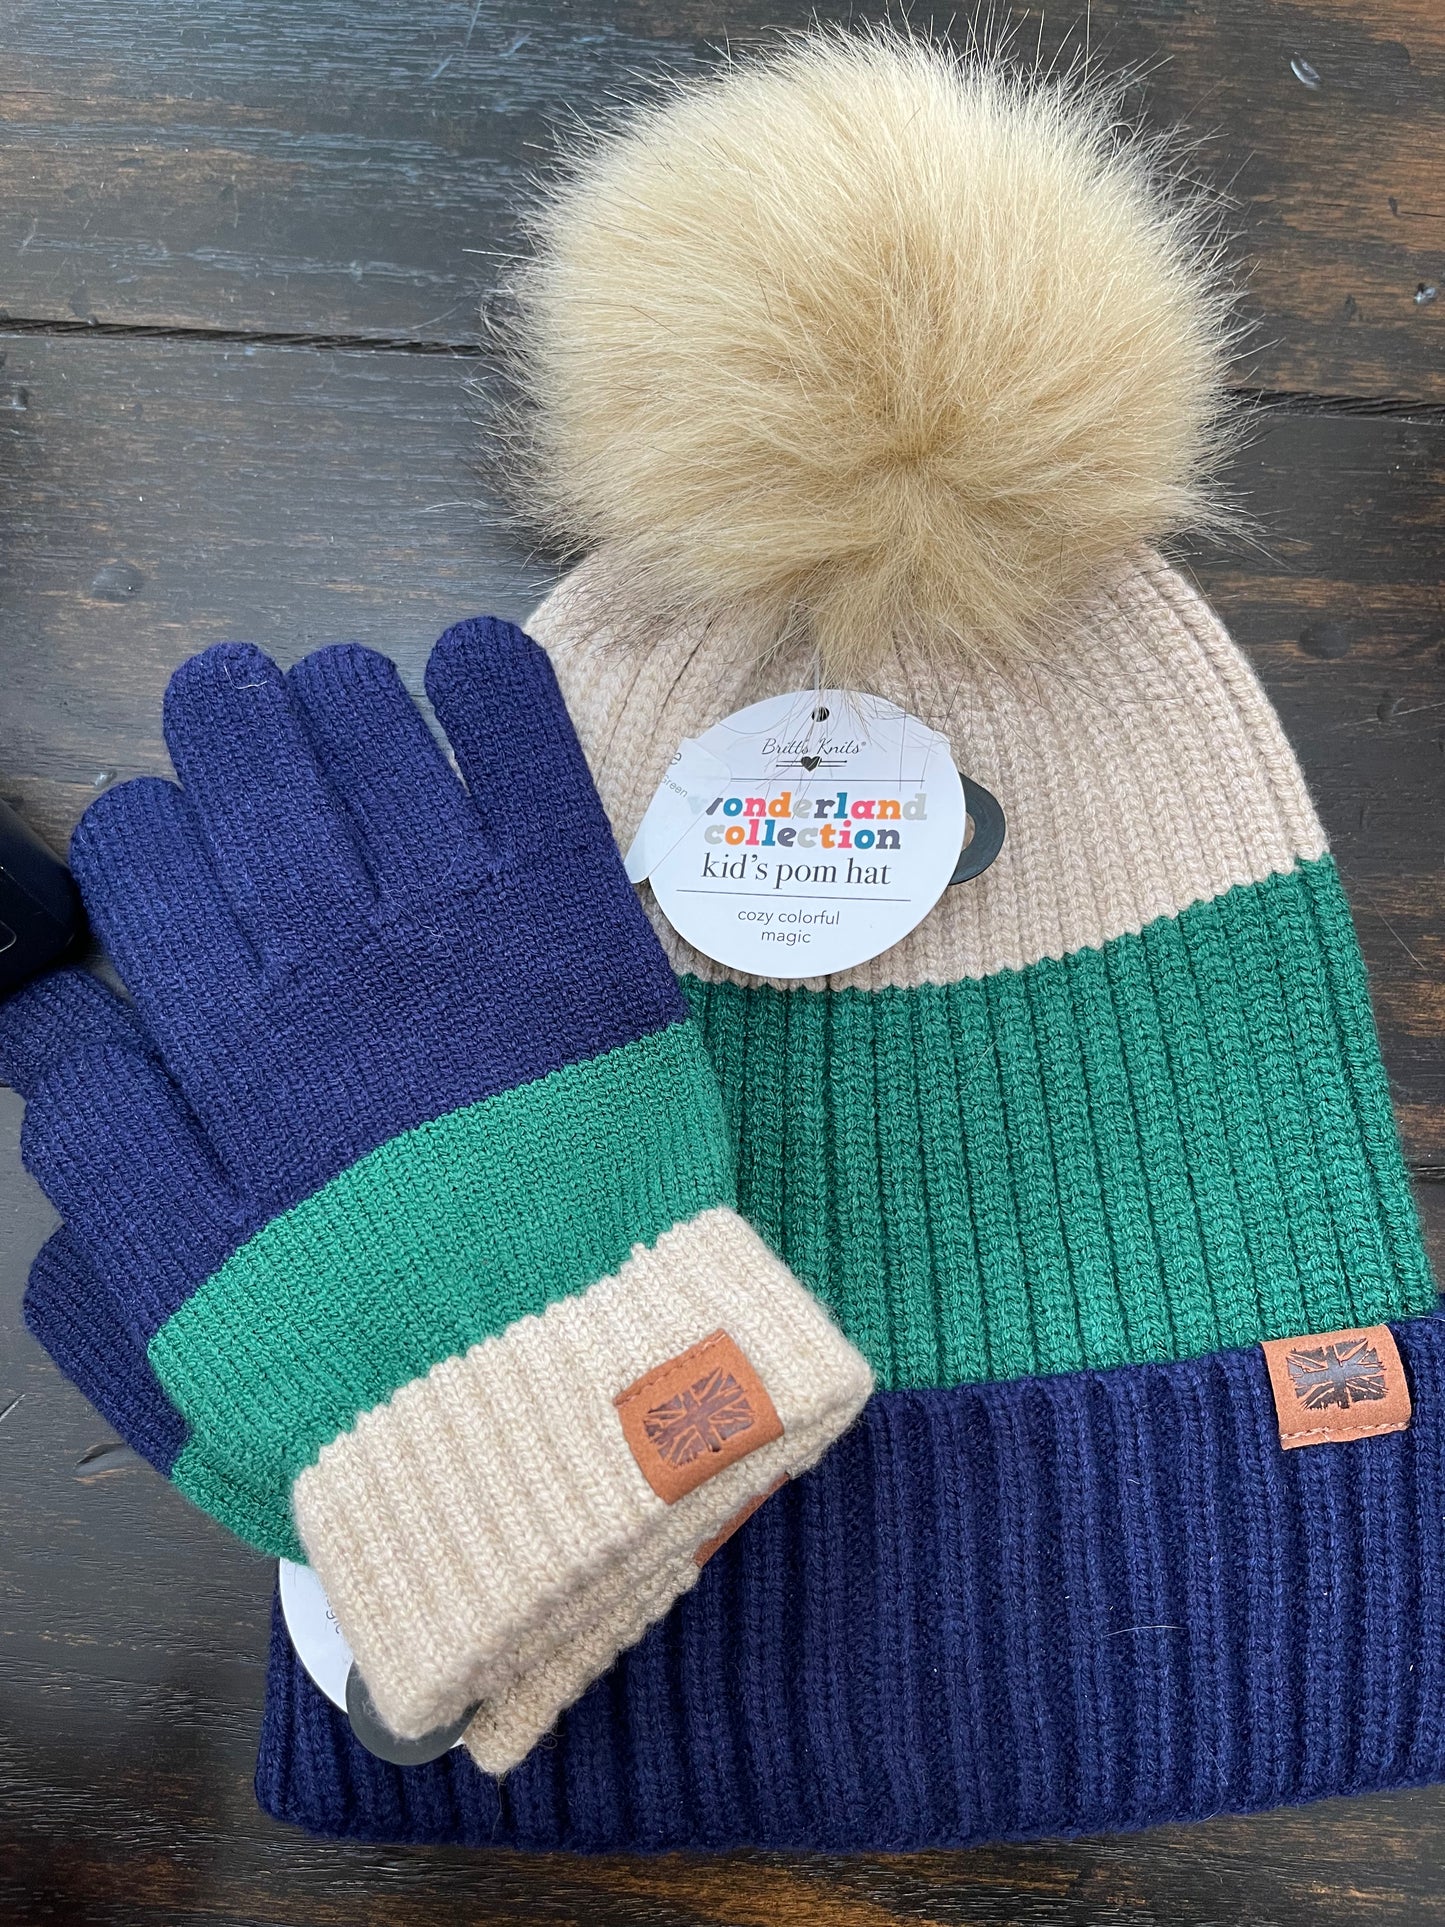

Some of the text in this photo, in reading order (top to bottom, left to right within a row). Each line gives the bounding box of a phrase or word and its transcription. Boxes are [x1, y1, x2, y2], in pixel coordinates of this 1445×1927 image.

[704, 819, 902, 850] collection
[700, 852, 892, 889] kid's pom hat
[737, 909, 840, 925] cozy colorful
[761, 929, 812, 946] magic
